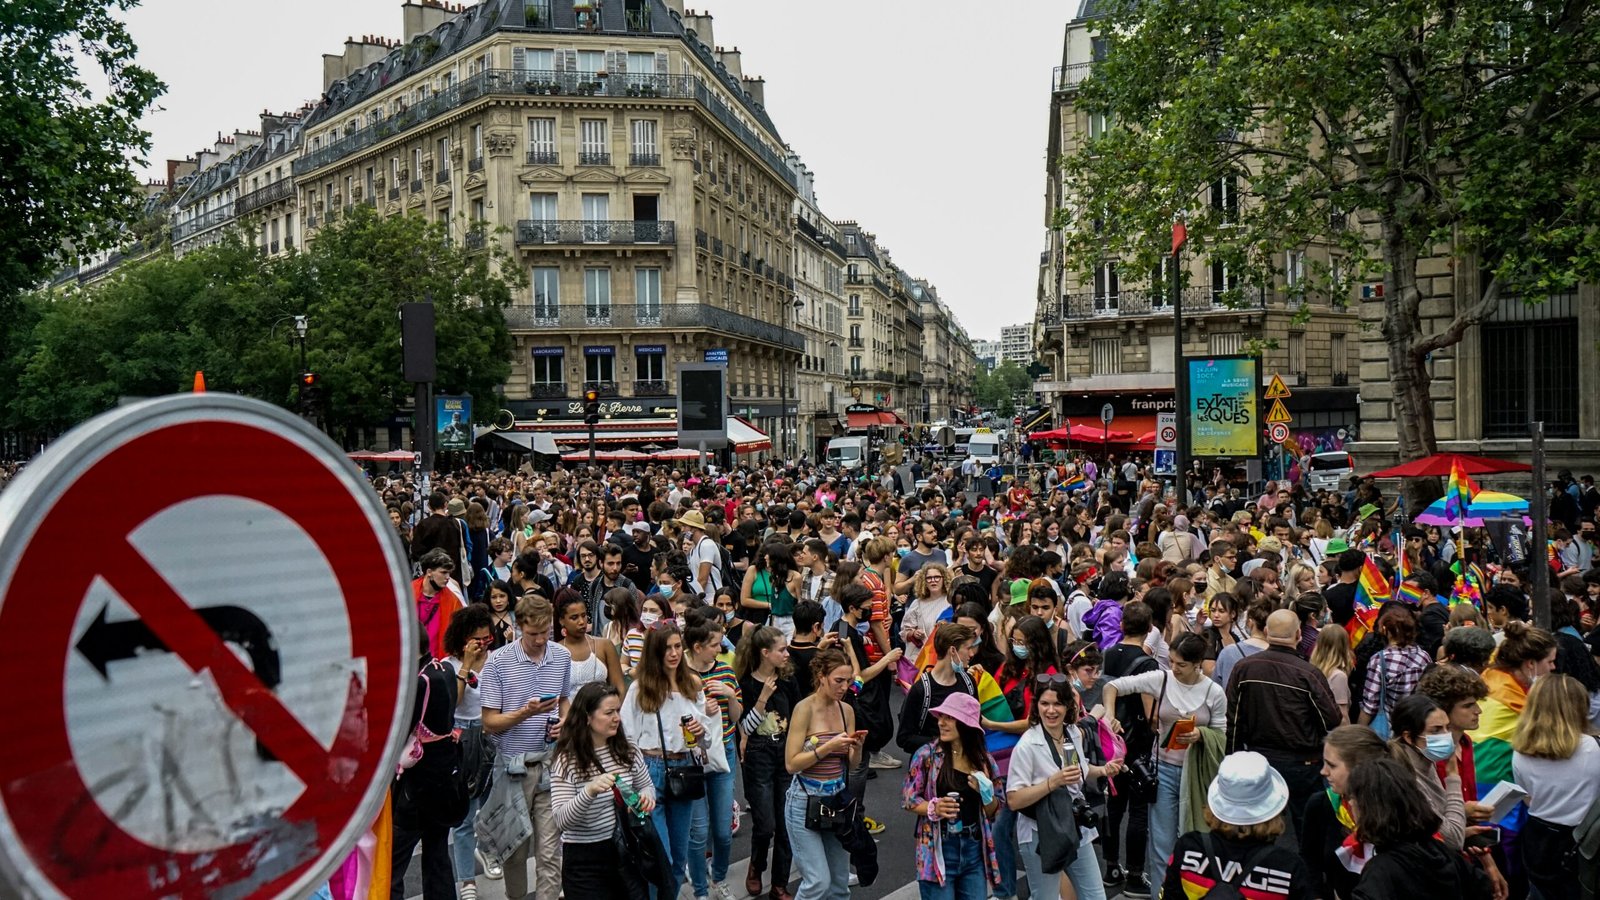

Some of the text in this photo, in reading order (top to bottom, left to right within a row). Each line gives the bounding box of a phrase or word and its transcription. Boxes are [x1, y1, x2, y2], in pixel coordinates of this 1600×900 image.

[567, 402, 585, 414] Le
[609, 401, 643, 416] Pierre
[1275, 428, 1285, 437] 30
